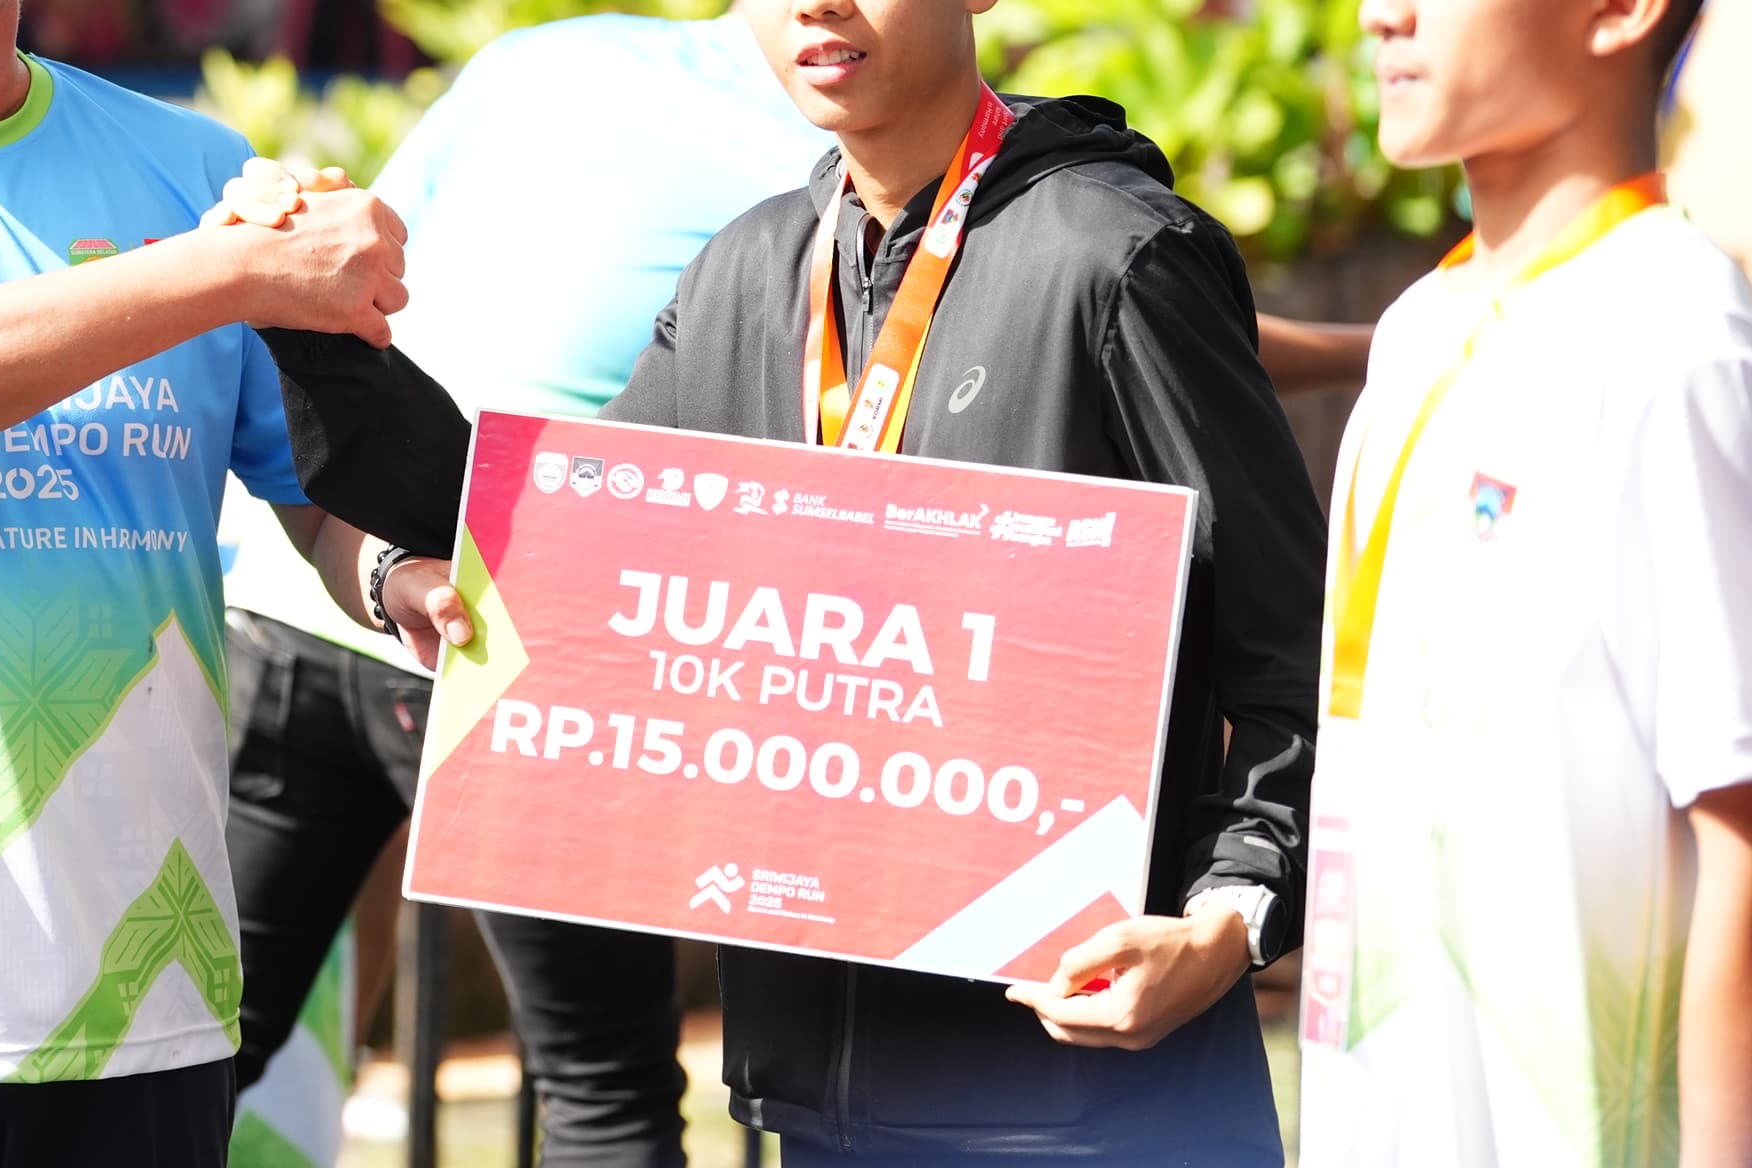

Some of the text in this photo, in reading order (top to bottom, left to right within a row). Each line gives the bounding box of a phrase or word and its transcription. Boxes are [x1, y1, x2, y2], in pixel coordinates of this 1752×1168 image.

[122, 423, 191, 460] RUN
[793, 492, 827, 507] BANK
[791, 504, 875, 525] SUMSELBABEL
[885, 503, 988, 530] BerAKHLAK
[74, 526, 98, 550] IN
[607, 568, 997, 683] JUARA 1
[648, 650, 944, 728] 10K PUTRA
[489, 698, 1085, 835] RP.15.000.000,-
[751, 868, 820, 889] SRIWIJAYA
[748, 894, 782, 909] 2025
[750, 881, 825, 902] DEMPO RUN
